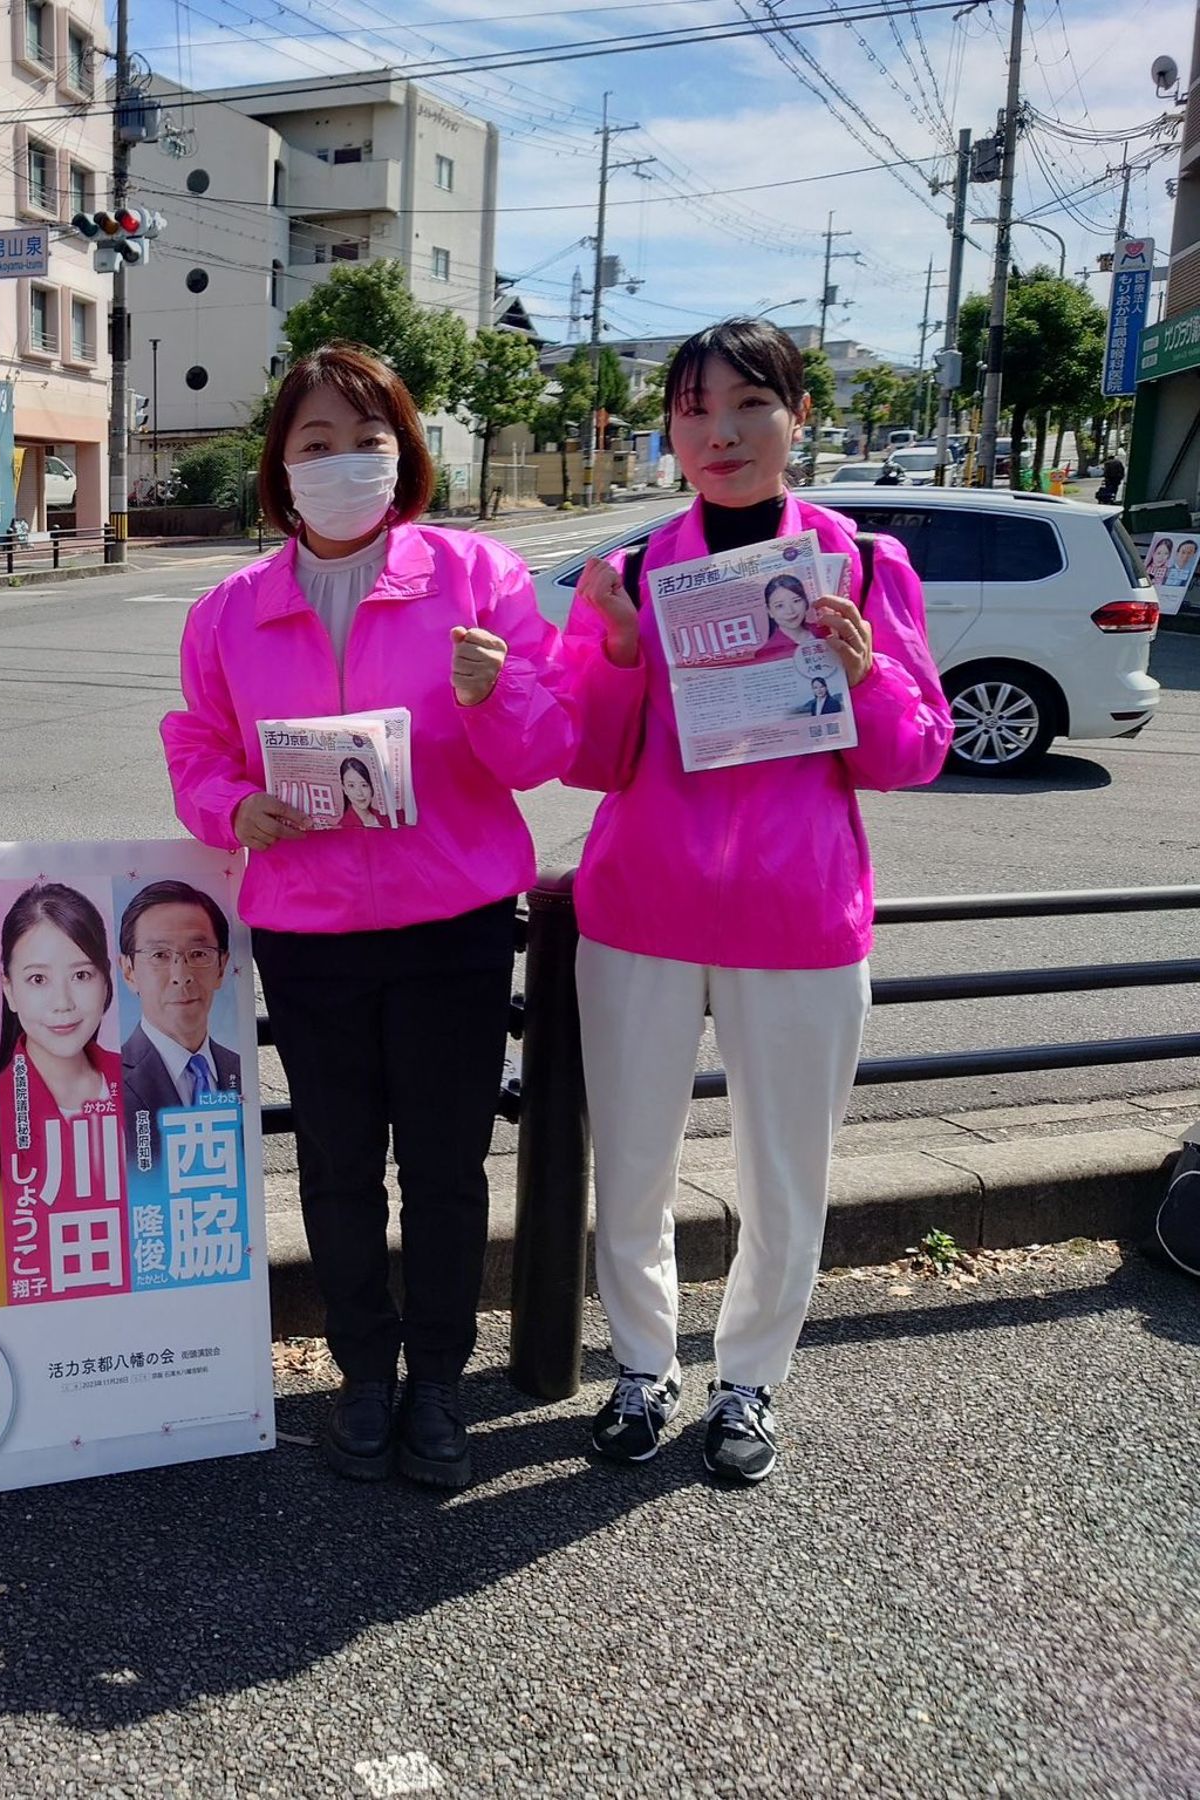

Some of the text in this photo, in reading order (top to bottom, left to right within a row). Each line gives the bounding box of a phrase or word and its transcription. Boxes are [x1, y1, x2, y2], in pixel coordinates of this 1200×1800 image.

[679, 614, 757, 658] 川田
[83, 1101, 117, 1114] かわた
[200, 1093, 237, 1105] にしわき
[136, 1110, 152, 1172] 京都府知事
[11, 1154, 40, 1276] しょうこ
[40, 1116, 125, 1294] 川田
[162, 1108, 242, 1280] 西脇
[133, 1205, 167, 1273] 隆俊
[12, 1279, 48, 1299] 翔子
[136, 1273, 169, 1286] たかとし
[48, 1348, 175, 1380] 活力京都八幡の会
